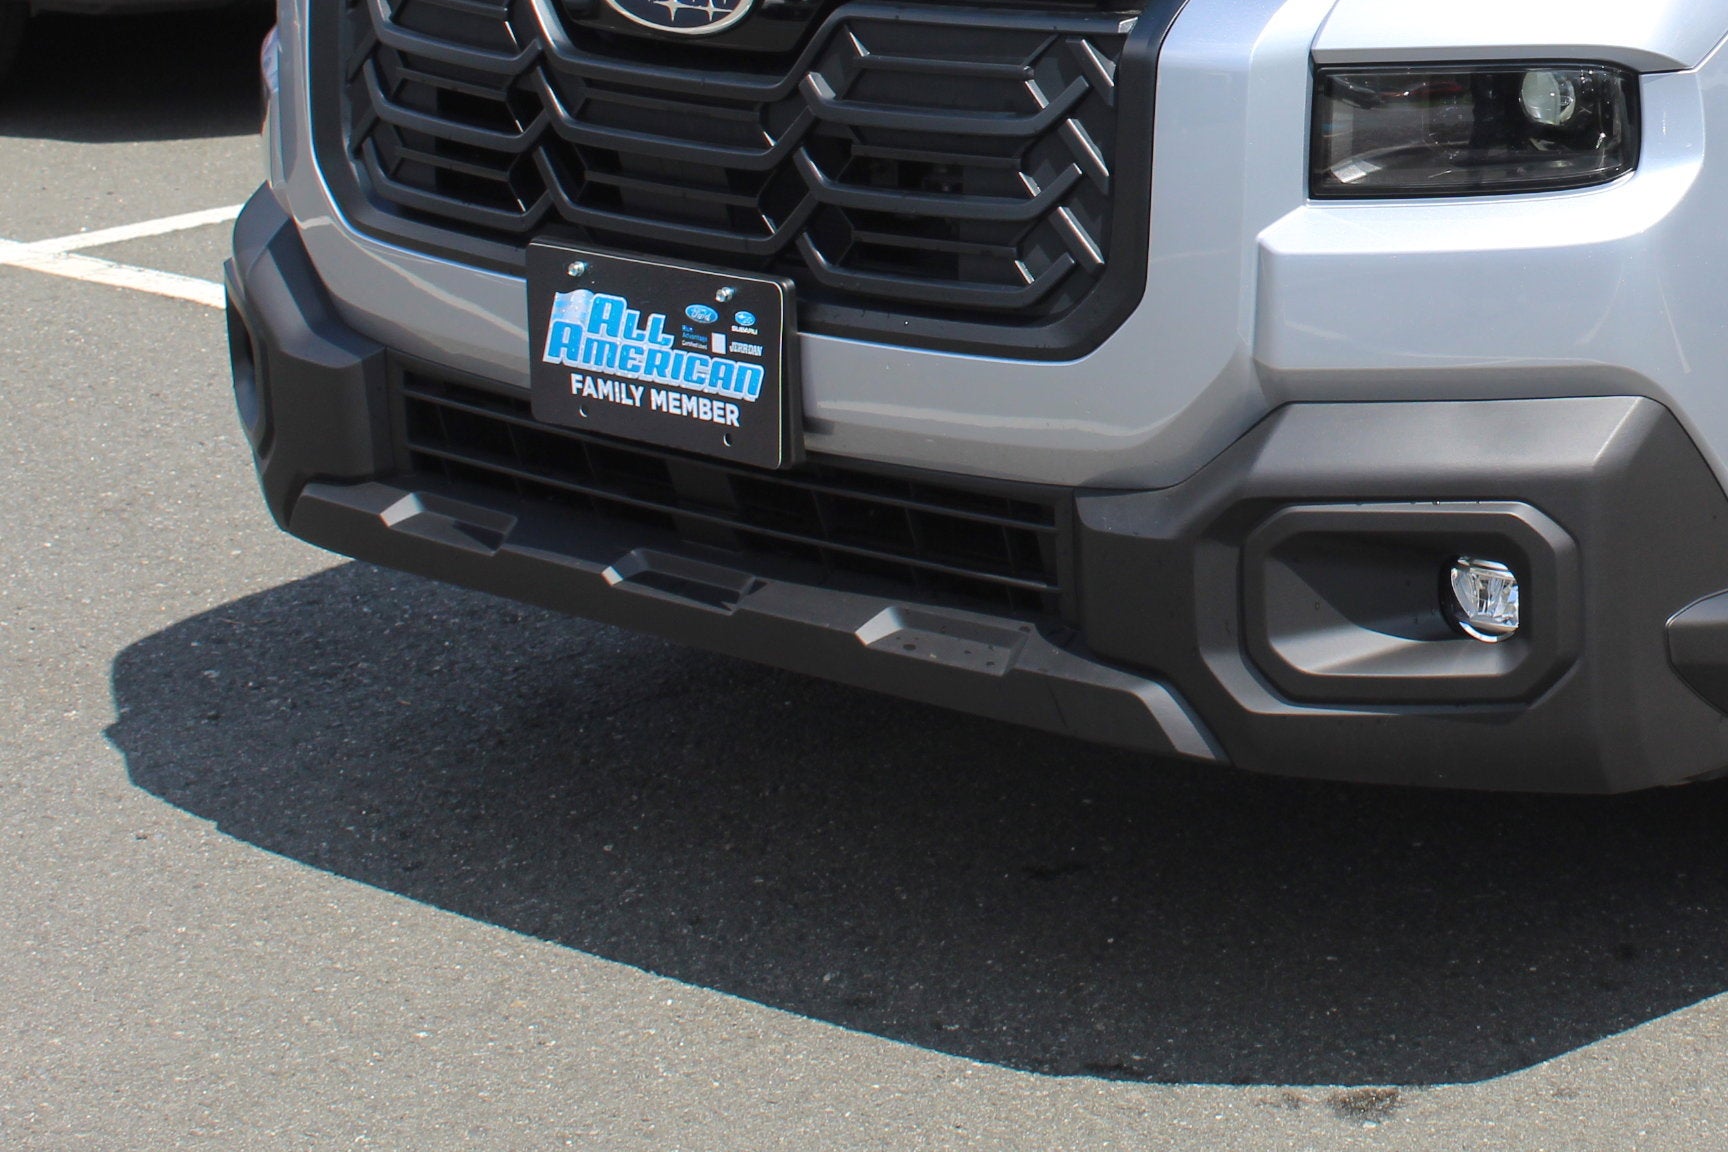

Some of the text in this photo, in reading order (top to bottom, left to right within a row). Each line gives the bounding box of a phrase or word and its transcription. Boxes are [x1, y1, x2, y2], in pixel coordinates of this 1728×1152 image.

[587, 293, 675, 348] ALL
[543, 319, 765, 403] AMERICAN
[570, 373, 740, 428] FAMILY MEMBER
